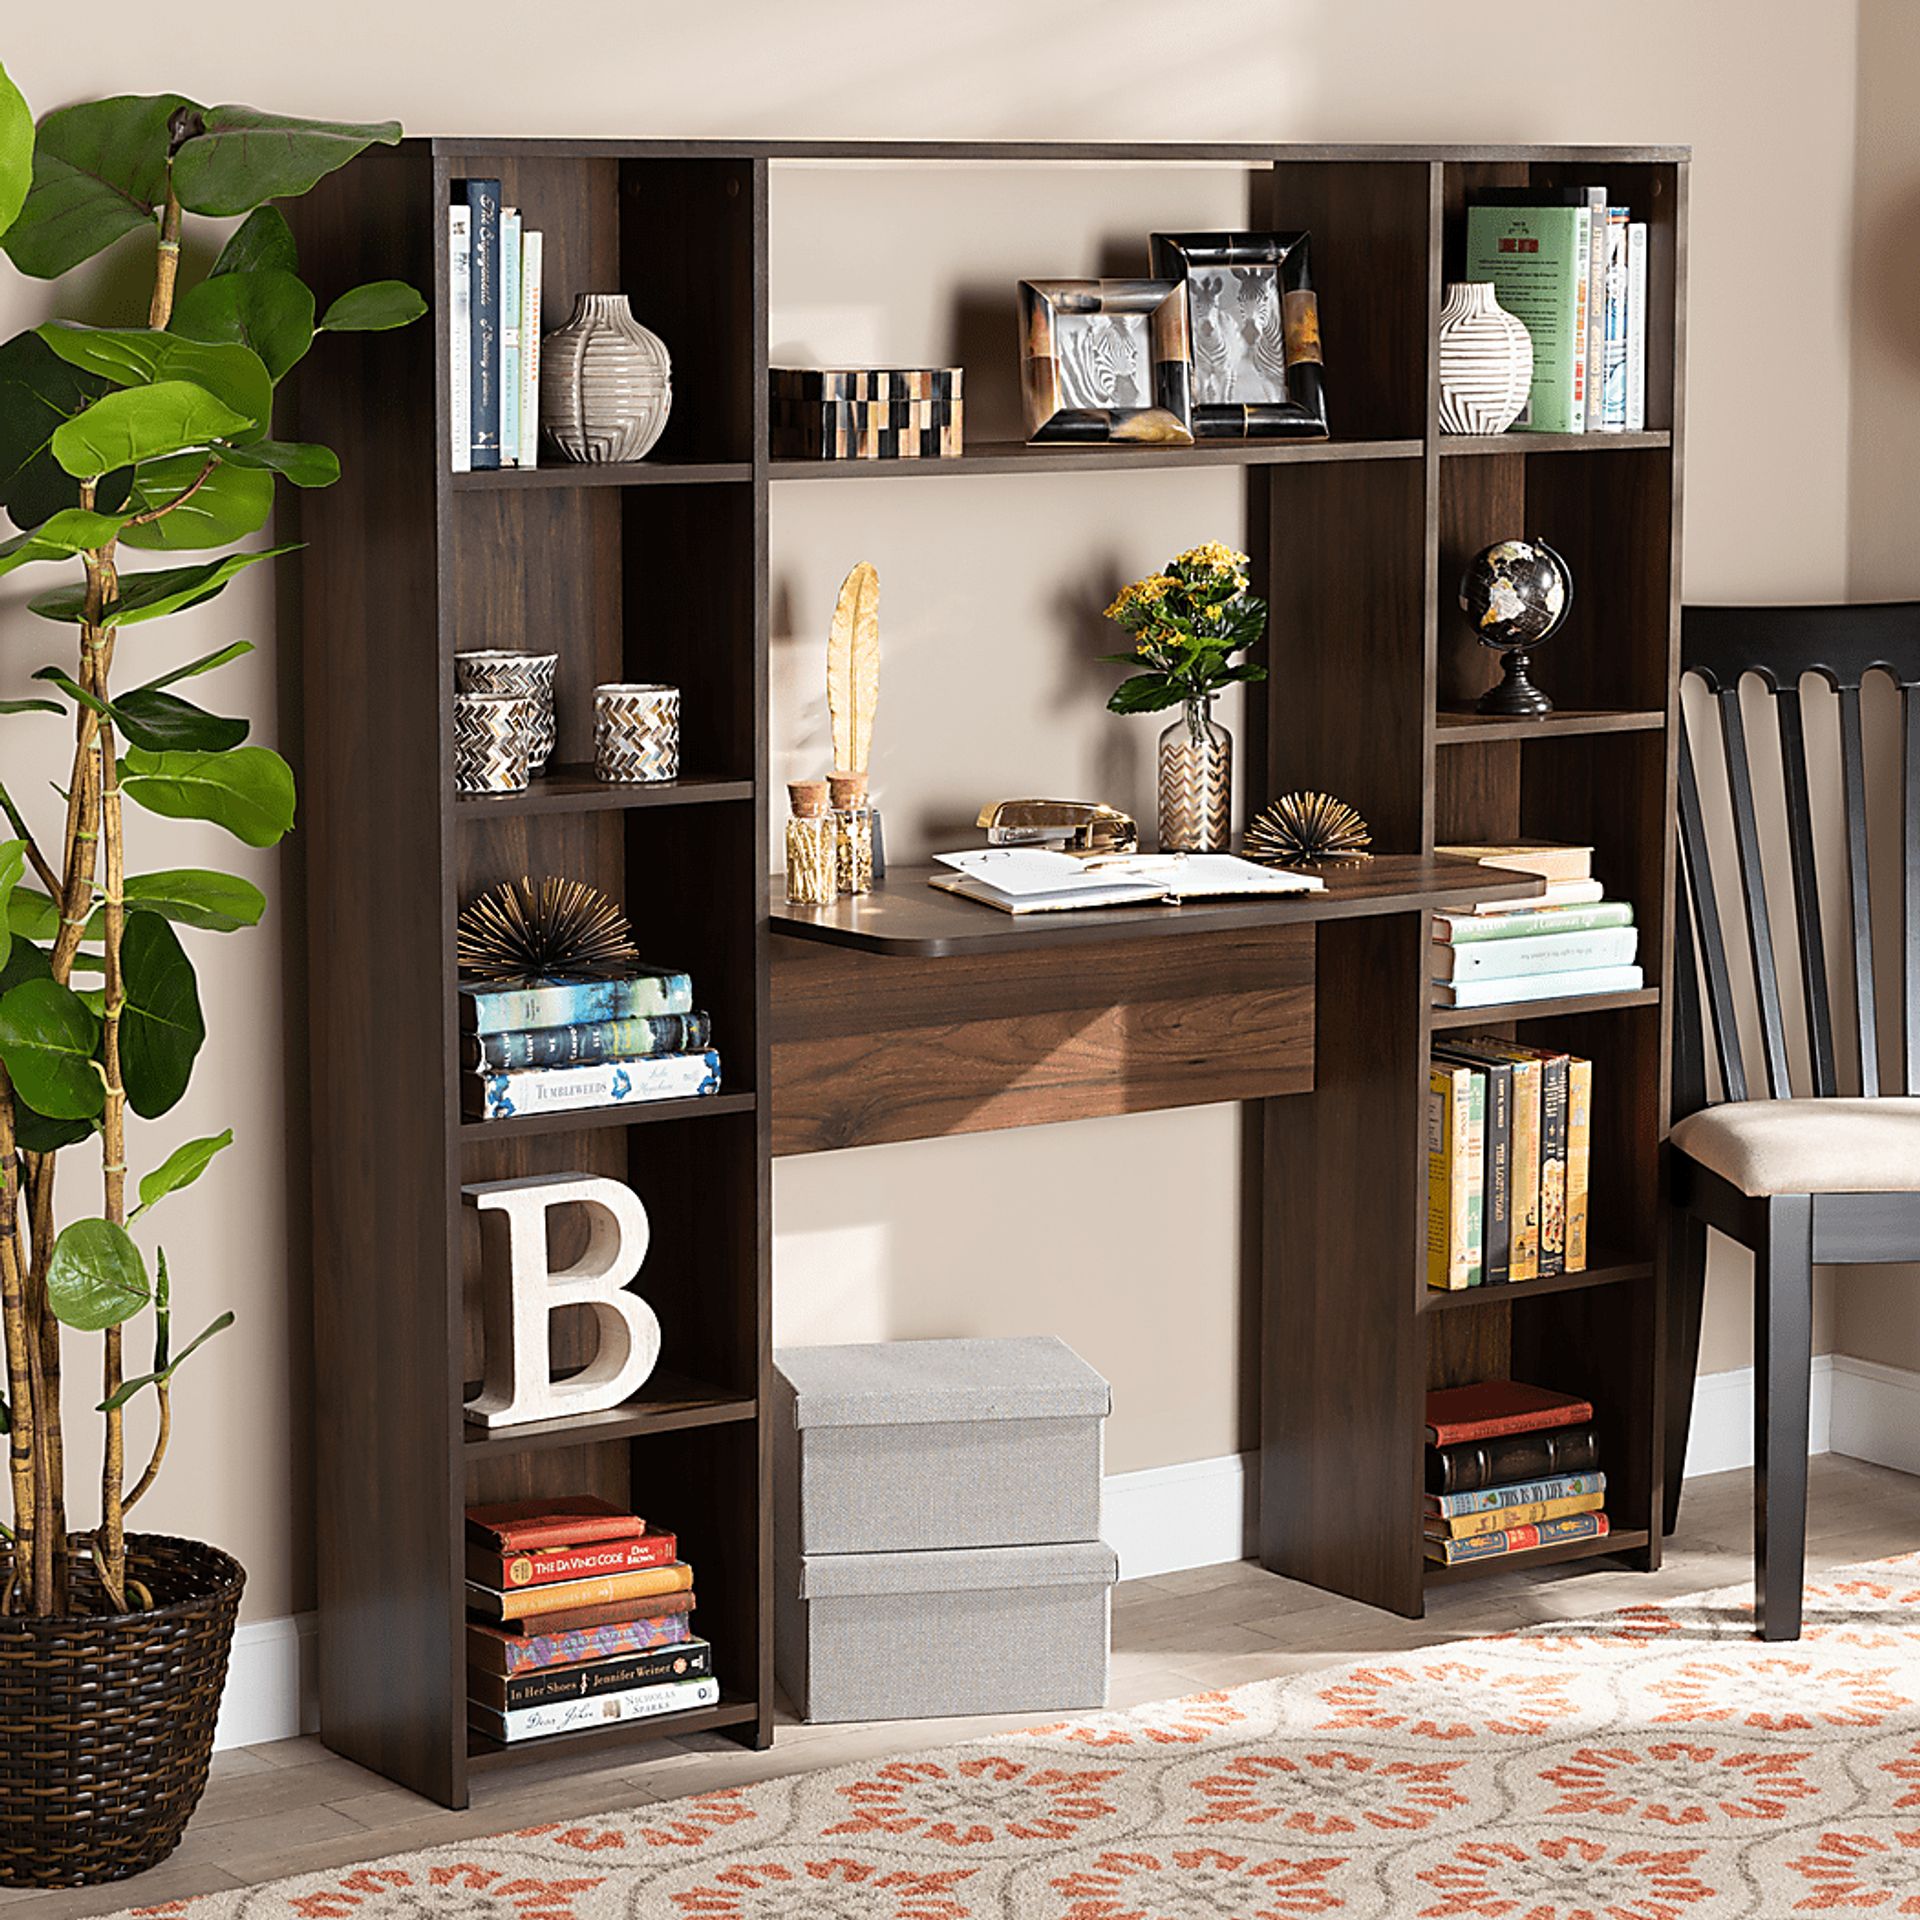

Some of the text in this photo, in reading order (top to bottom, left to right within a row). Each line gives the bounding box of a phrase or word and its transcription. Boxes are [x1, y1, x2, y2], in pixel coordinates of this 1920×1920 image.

[526, 1033, 534, 1062] LIGHT
[535, 1082, 607, 1100] TUMBLEWEEDS
[1496, 1143, 1505, 1164] THE
[477, 1177, 662, 1428] B
[1498, 1489, 1520, 1507] THIS
[535, 1561, 555, 1575] THE
[556, 1558, 571, 1573] DA
[569, 1556, 598, 1570] VINCI
[598, 1552, 624, 1566] CODE
[627, 1554, 656, 1566] BROWN
[593, 1664, 672, 1688] Jennifer Weiner
[510, 1682, 577, 1700] In Her Shoes
[632, 1702, 671, 1715] SPARKS
